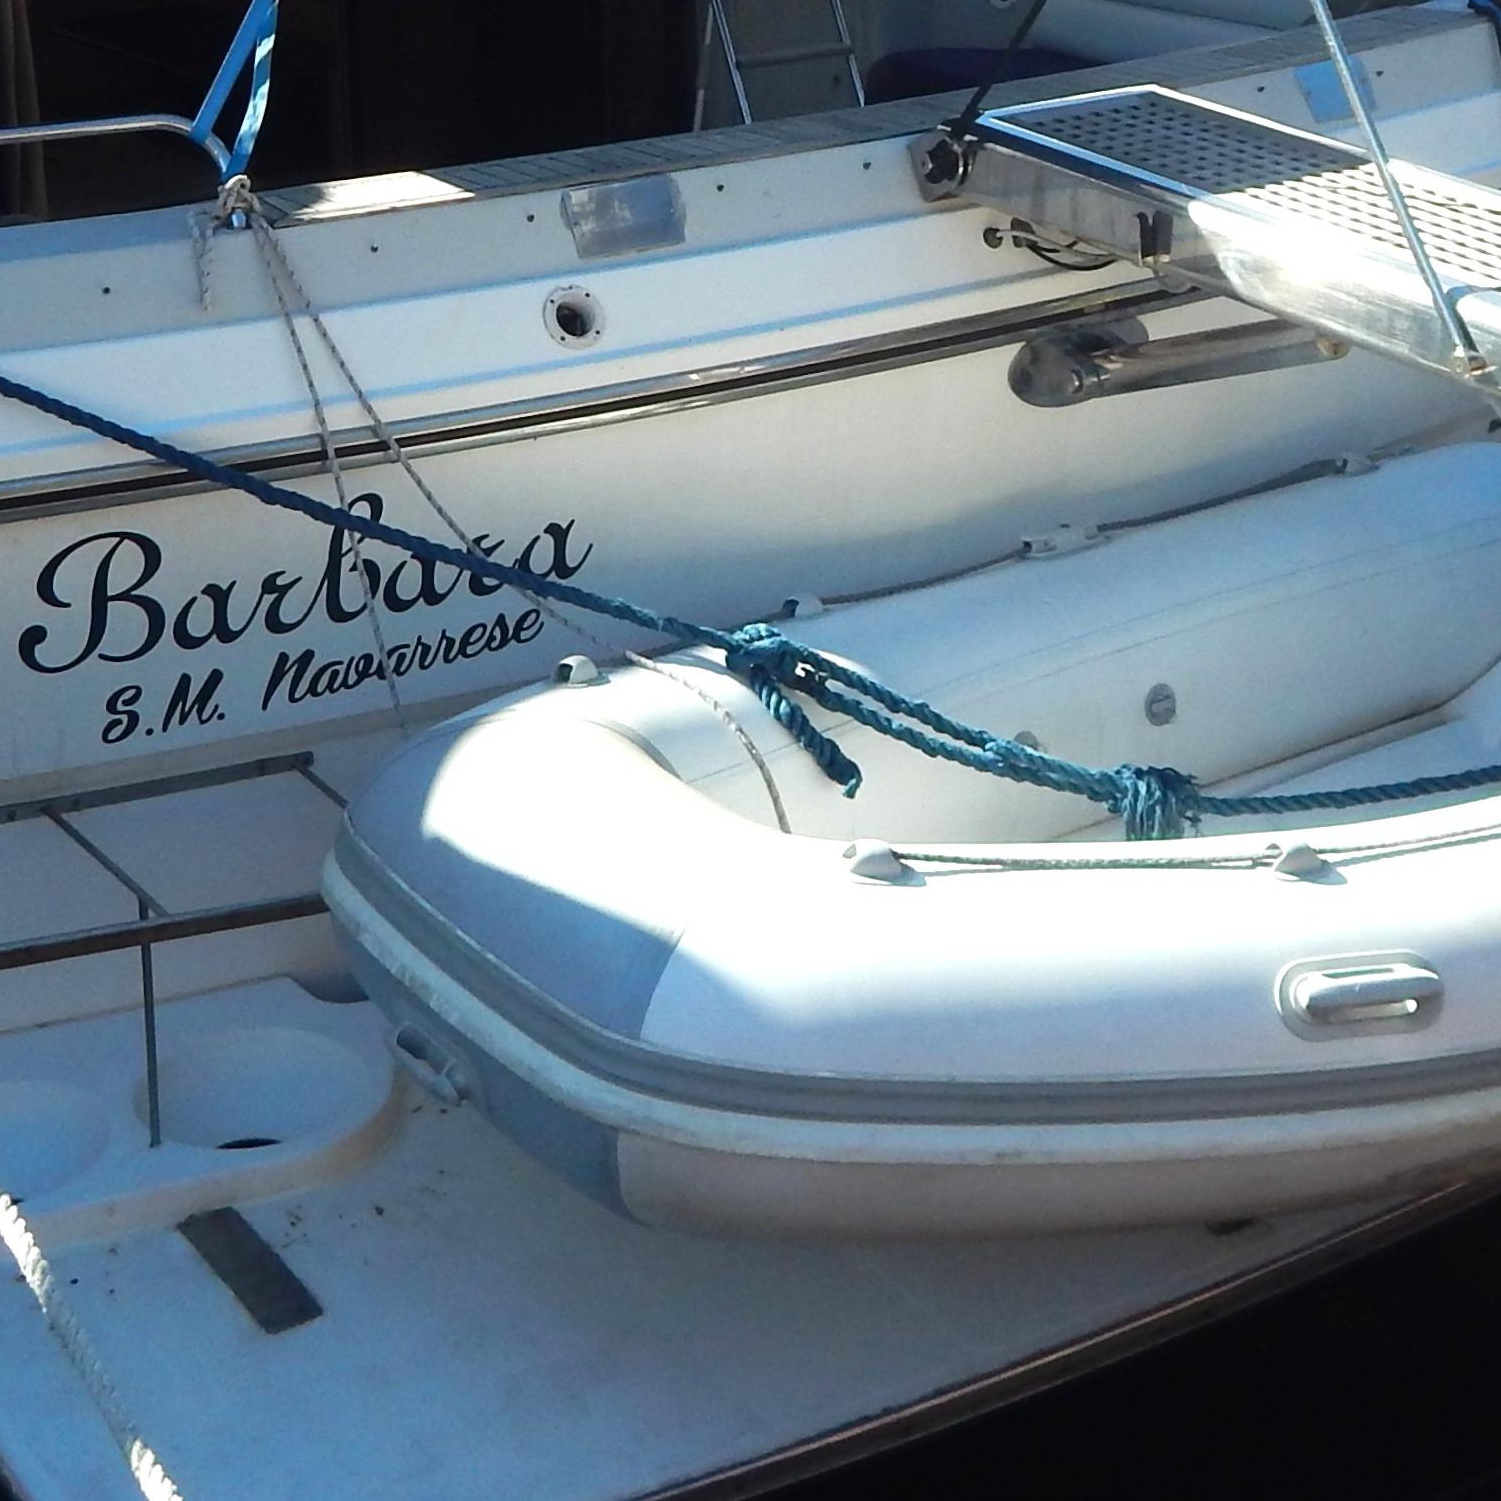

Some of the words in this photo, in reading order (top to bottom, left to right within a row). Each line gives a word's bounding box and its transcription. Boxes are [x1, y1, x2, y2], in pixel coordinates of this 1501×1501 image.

[18, 492, 594, 674] Barbara
[101, 667, 226, 745] S.M.
[261, 607, 545, 712] Navarrese
